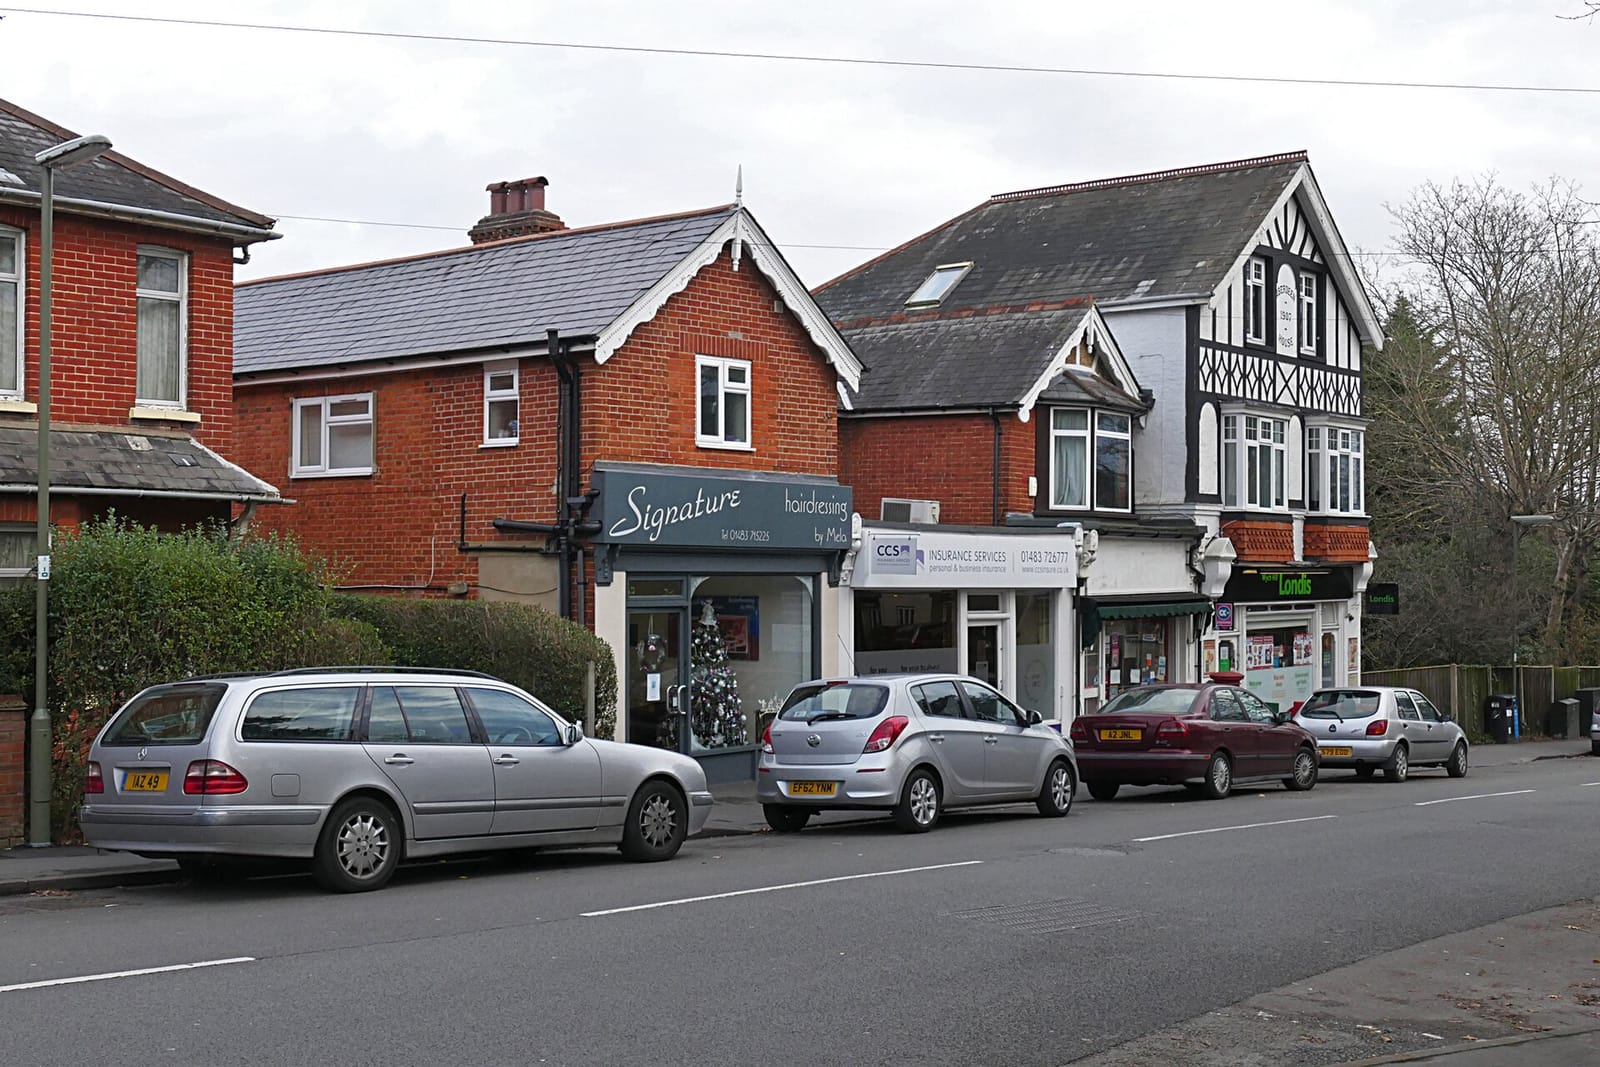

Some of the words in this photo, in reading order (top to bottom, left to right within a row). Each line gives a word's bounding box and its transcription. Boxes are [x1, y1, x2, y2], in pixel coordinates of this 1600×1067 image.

[1279, 333, 1294, 348] HOUSE
[784, 487, 848, 522] hairdressing
[608, 486, 741, 542] Signature
[730, 529, 749, 541] 01483
[814, 526, 824, 546] by
[877, 545, 900, 557] CCS
[929, 549, 972, 562] INSURANCE
[974, 551, 1006, 562] SERVICES
[1020, 550, 1042, 562] 01483
[1044, 551, 1069, 563] 726777
[929, 564, 952, 573] personal
[953, 564, 958, 572] &
[959, 564, 981, 573] business
[982, 565, 1006, 573] insurance
[1279, 572, 1311, 595] Londis
[1369, 595, 1394, 603] Londis
[1108, 730, 1118, 739] A2
[1120, 730, 1133, 739] JNL
[147, 775, 160, 789] 49
[792, 783, 814, 793] EF62
[815, 783, 833, 793] YNM
